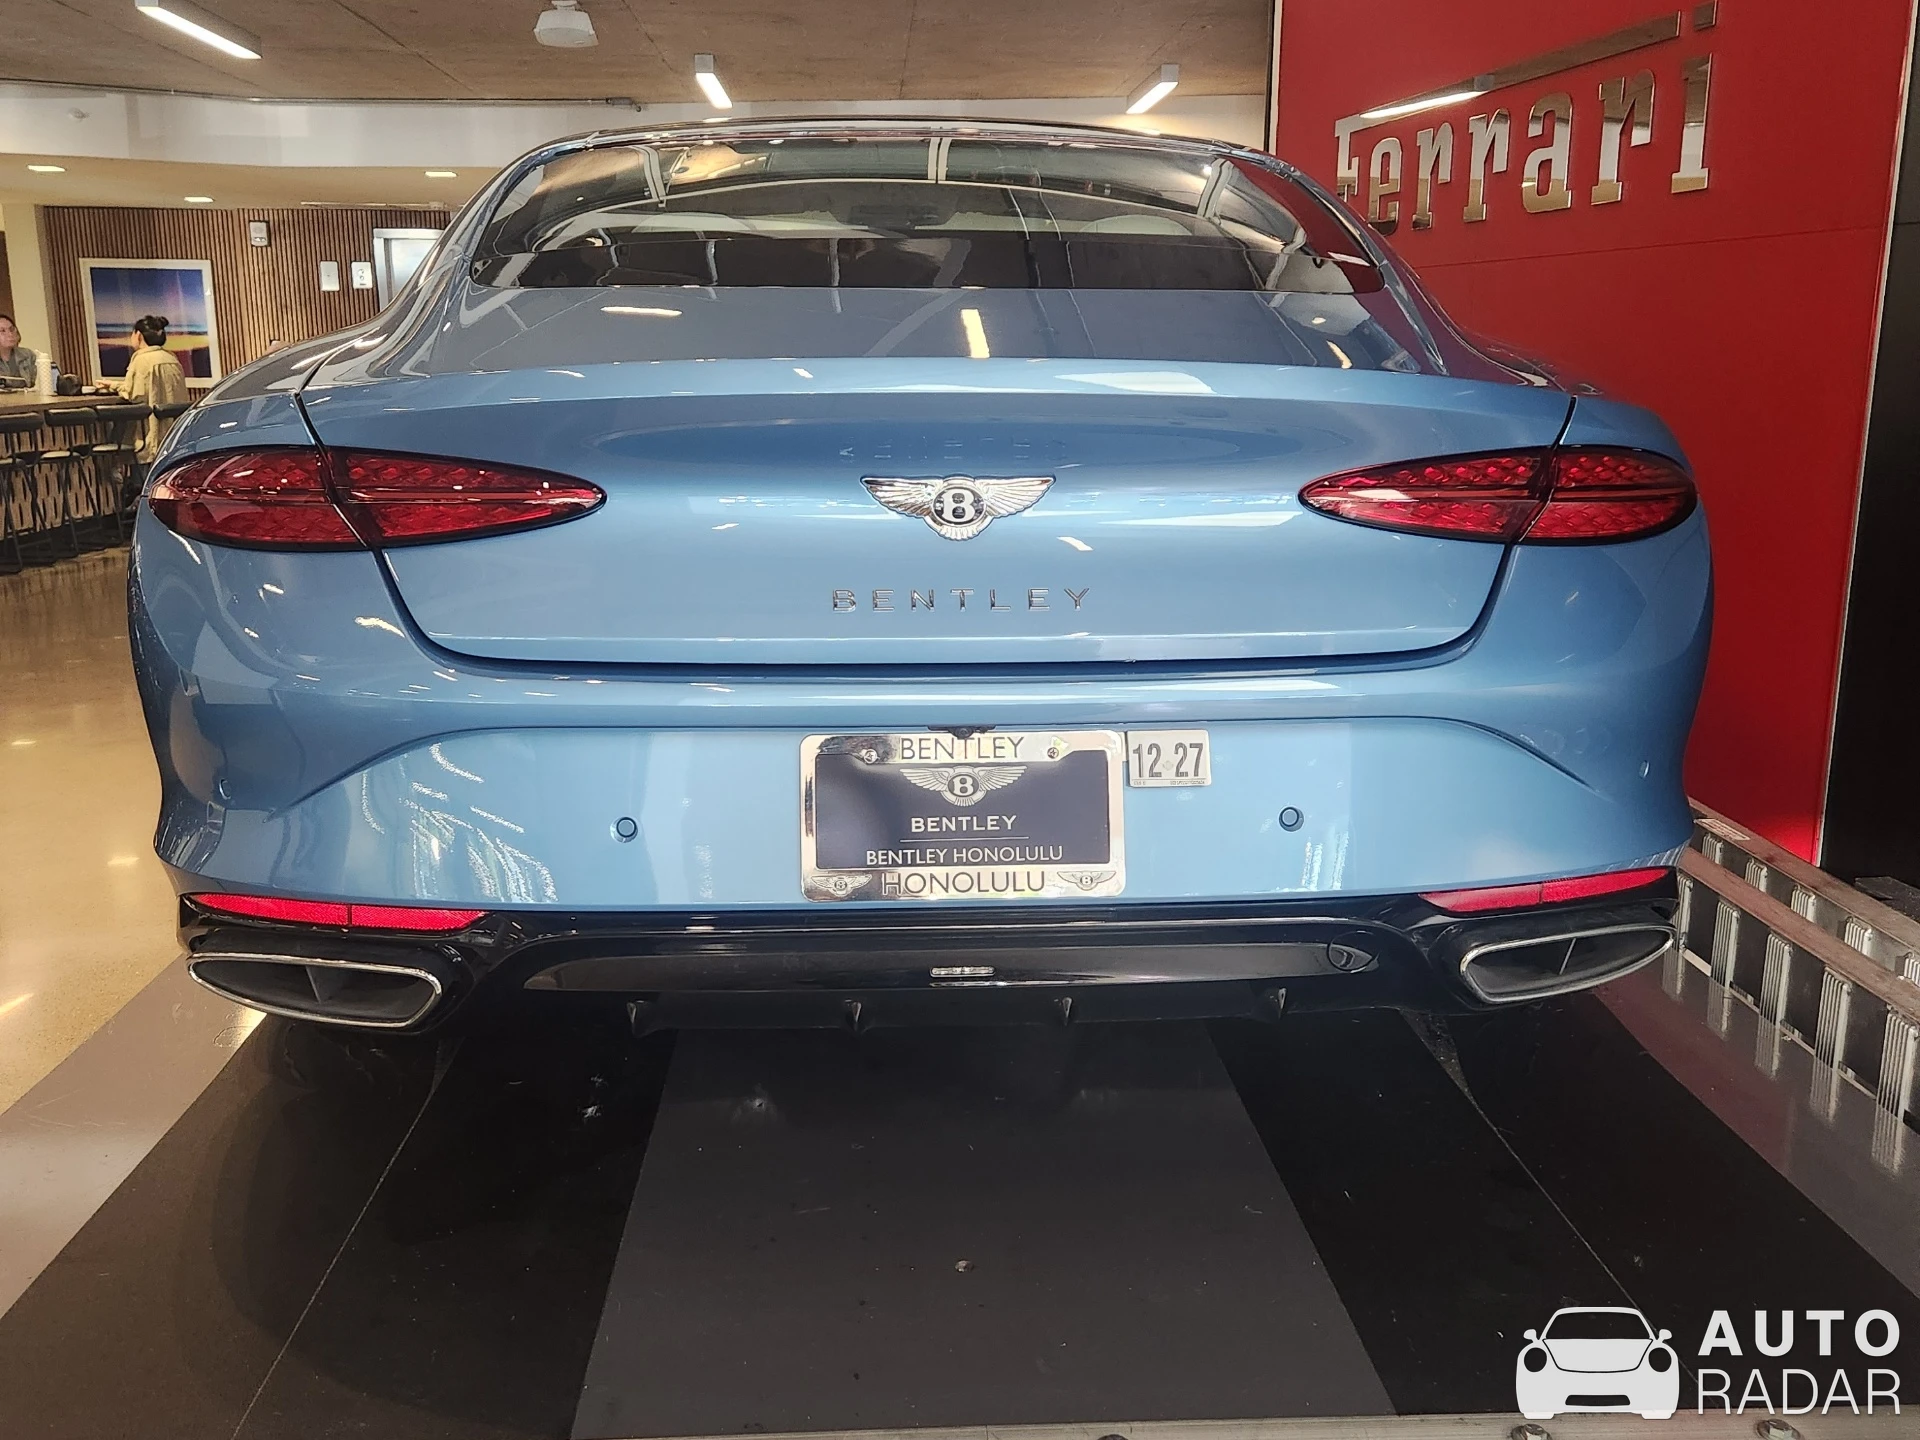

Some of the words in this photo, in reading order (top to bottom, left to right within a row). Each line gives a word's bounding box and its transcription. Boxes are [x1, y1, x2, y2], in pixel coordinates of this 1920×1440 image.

[1335, 0, 1718, 236] Ferrari
[942, 489, 975, 524] B
[833, 588, 1090, 612] BENTLEY
[901, 736, 1024, 760] BENTLEY
[1132, 742, 1163, 778] 12
[1174, 741, 1205, 778] 27
[951, 774, 974, 797] B
[911, 815, 1017, 833] BENTLEY
[866, 847, 946, 866] BENTLEY
[953, 845, 1063, 863] HONOLULU
[881, 871, 1046, 896] HONOLULU
